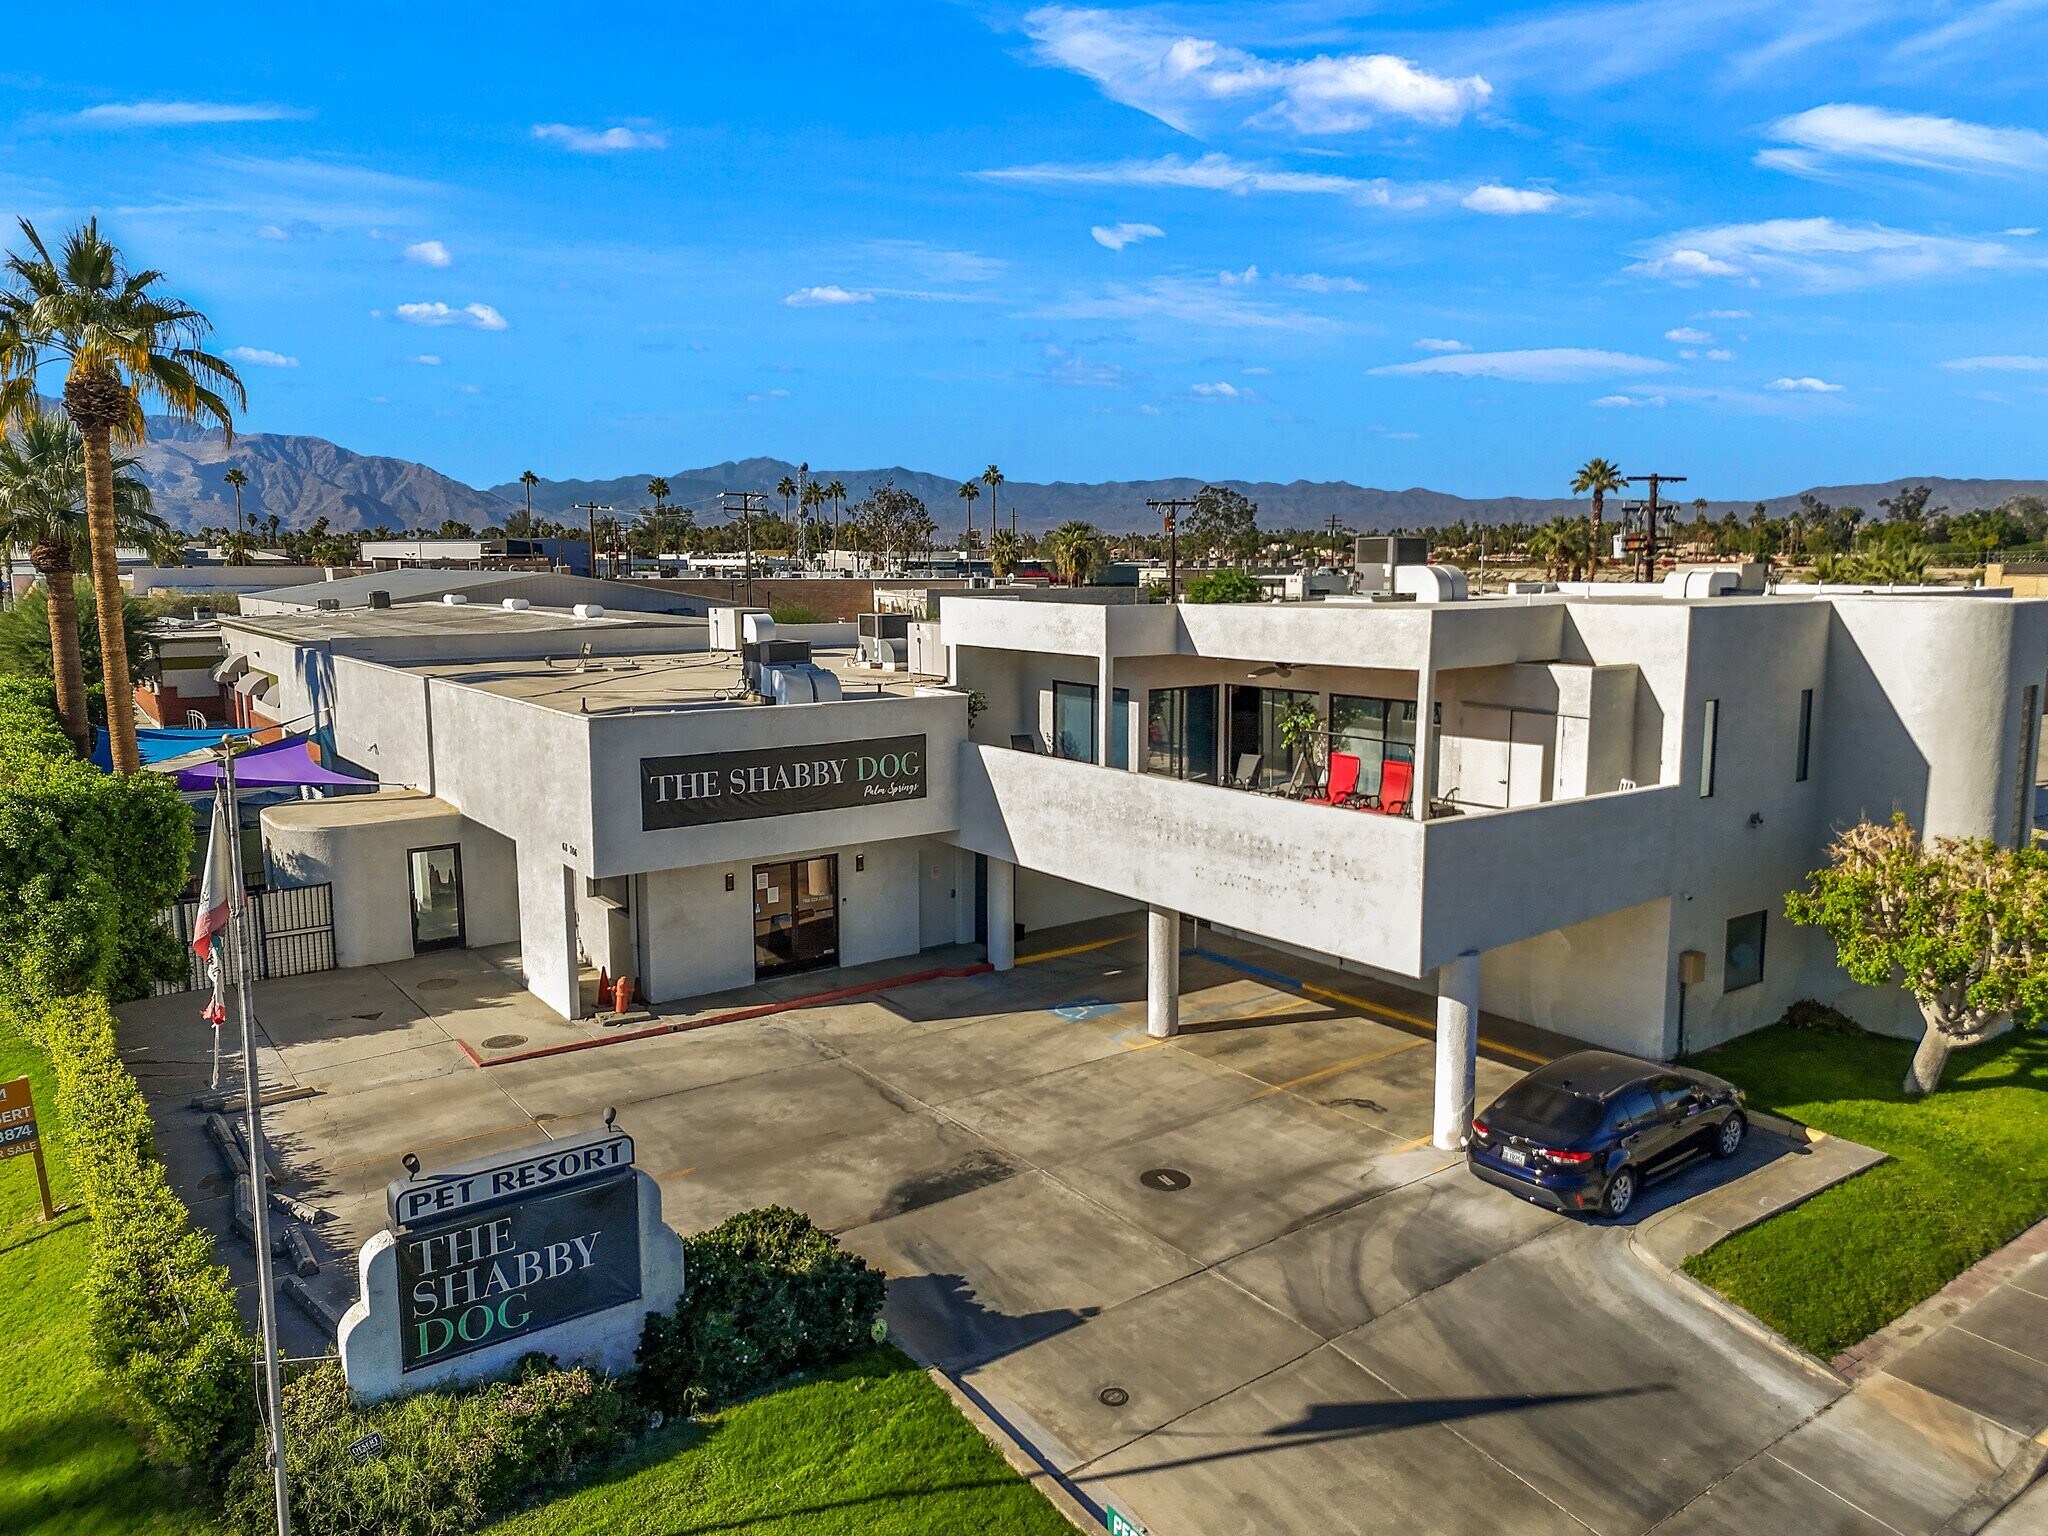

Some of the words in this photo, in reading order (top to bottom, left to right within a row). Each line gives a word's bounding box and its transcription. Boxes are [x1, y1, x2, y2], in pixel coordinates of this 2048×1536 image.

[650, 771, 721, 803] THE
[730, 758, 848, 796] SHABBY
[856, 751, 920, 782] DOG
[864, 784, 886, 798] Palm
[887, 781, 919, 797] Springs
[7, 1141, 37, 1156] SALE
[408, 1179, 475, 1217] PET
[492, 1141, 622, 1195] RESORT
[409, 1217, 516, 1277] THE
[412, 1231, 601, 1319] SHABBY
[415, 1292, 533, 1359] DOG
